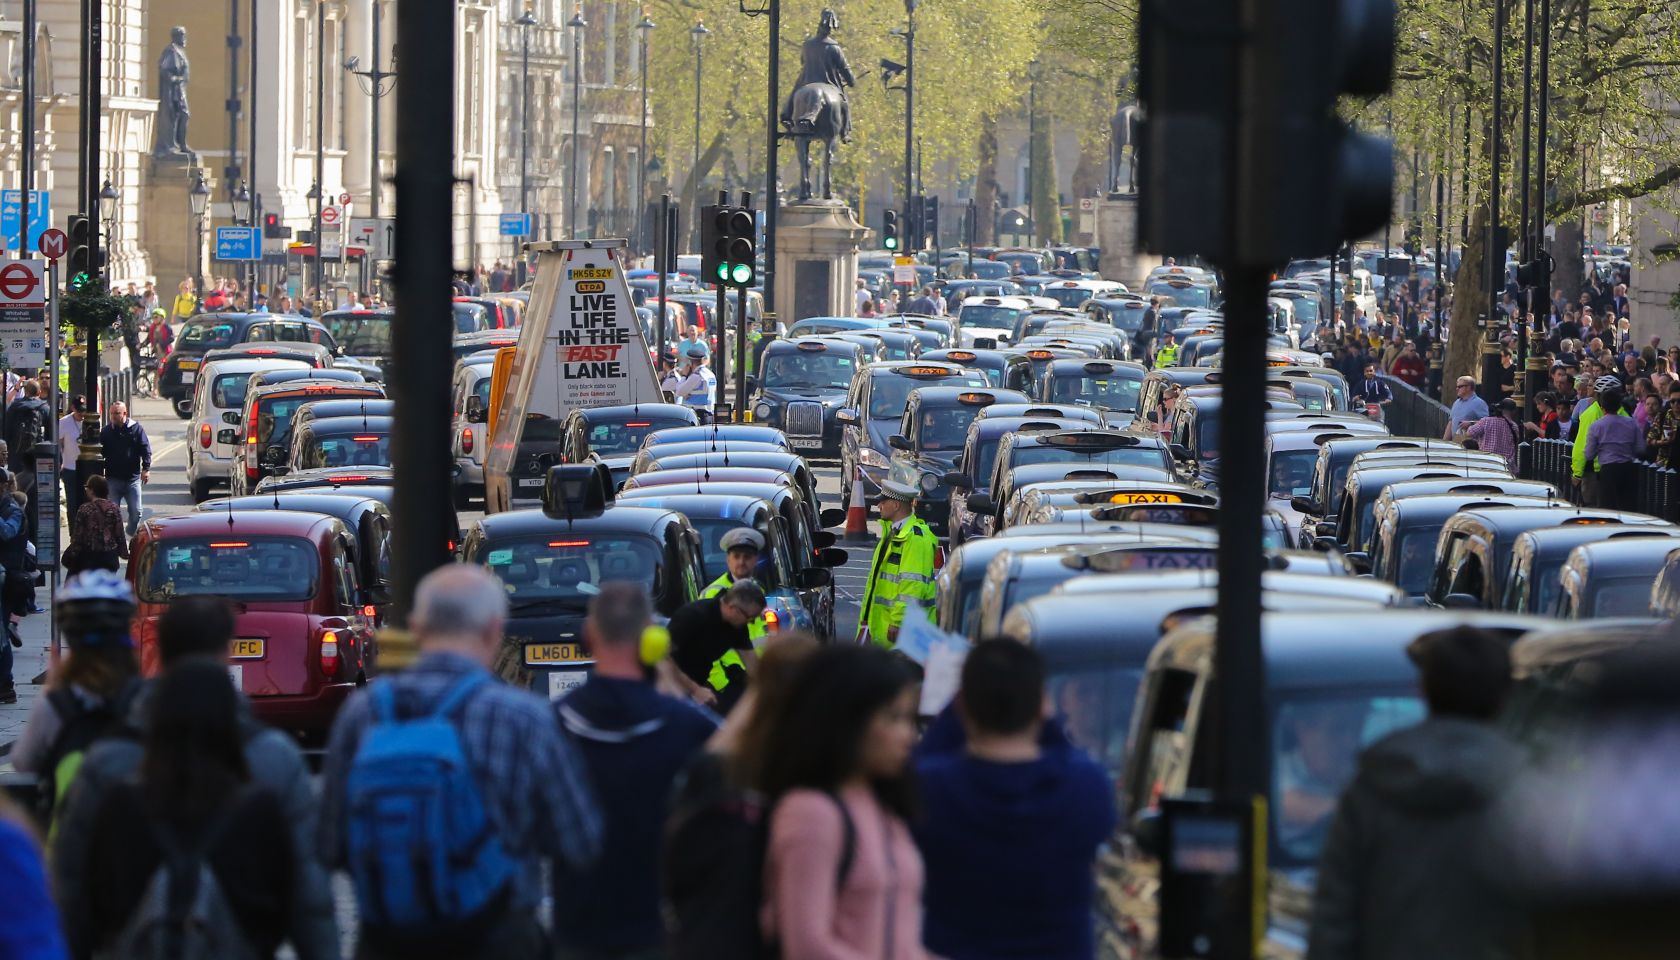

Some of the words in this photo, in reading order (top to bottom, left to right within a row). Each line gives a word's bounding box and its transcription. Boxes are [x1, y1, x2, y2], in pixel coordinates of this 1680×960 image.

[43, 234, 64, 253] M
[573, 270, 594, 278] HK56
[596, 269, 612, 278] SZY
[570, 294, 616, 311] LIVE
[571, 312, 617, 328] LIFE
[559, 330, 580, 345] IN
[586, 328, 630, 345] THE
[567, 345, 622, 362] FAST
[564, 362, 627, 379] LANE.
[1125, 494, 1168, 503] TAXI
[1143, 555, 1214, 567] TAXI
[532, 646, 570, 659] LM60
